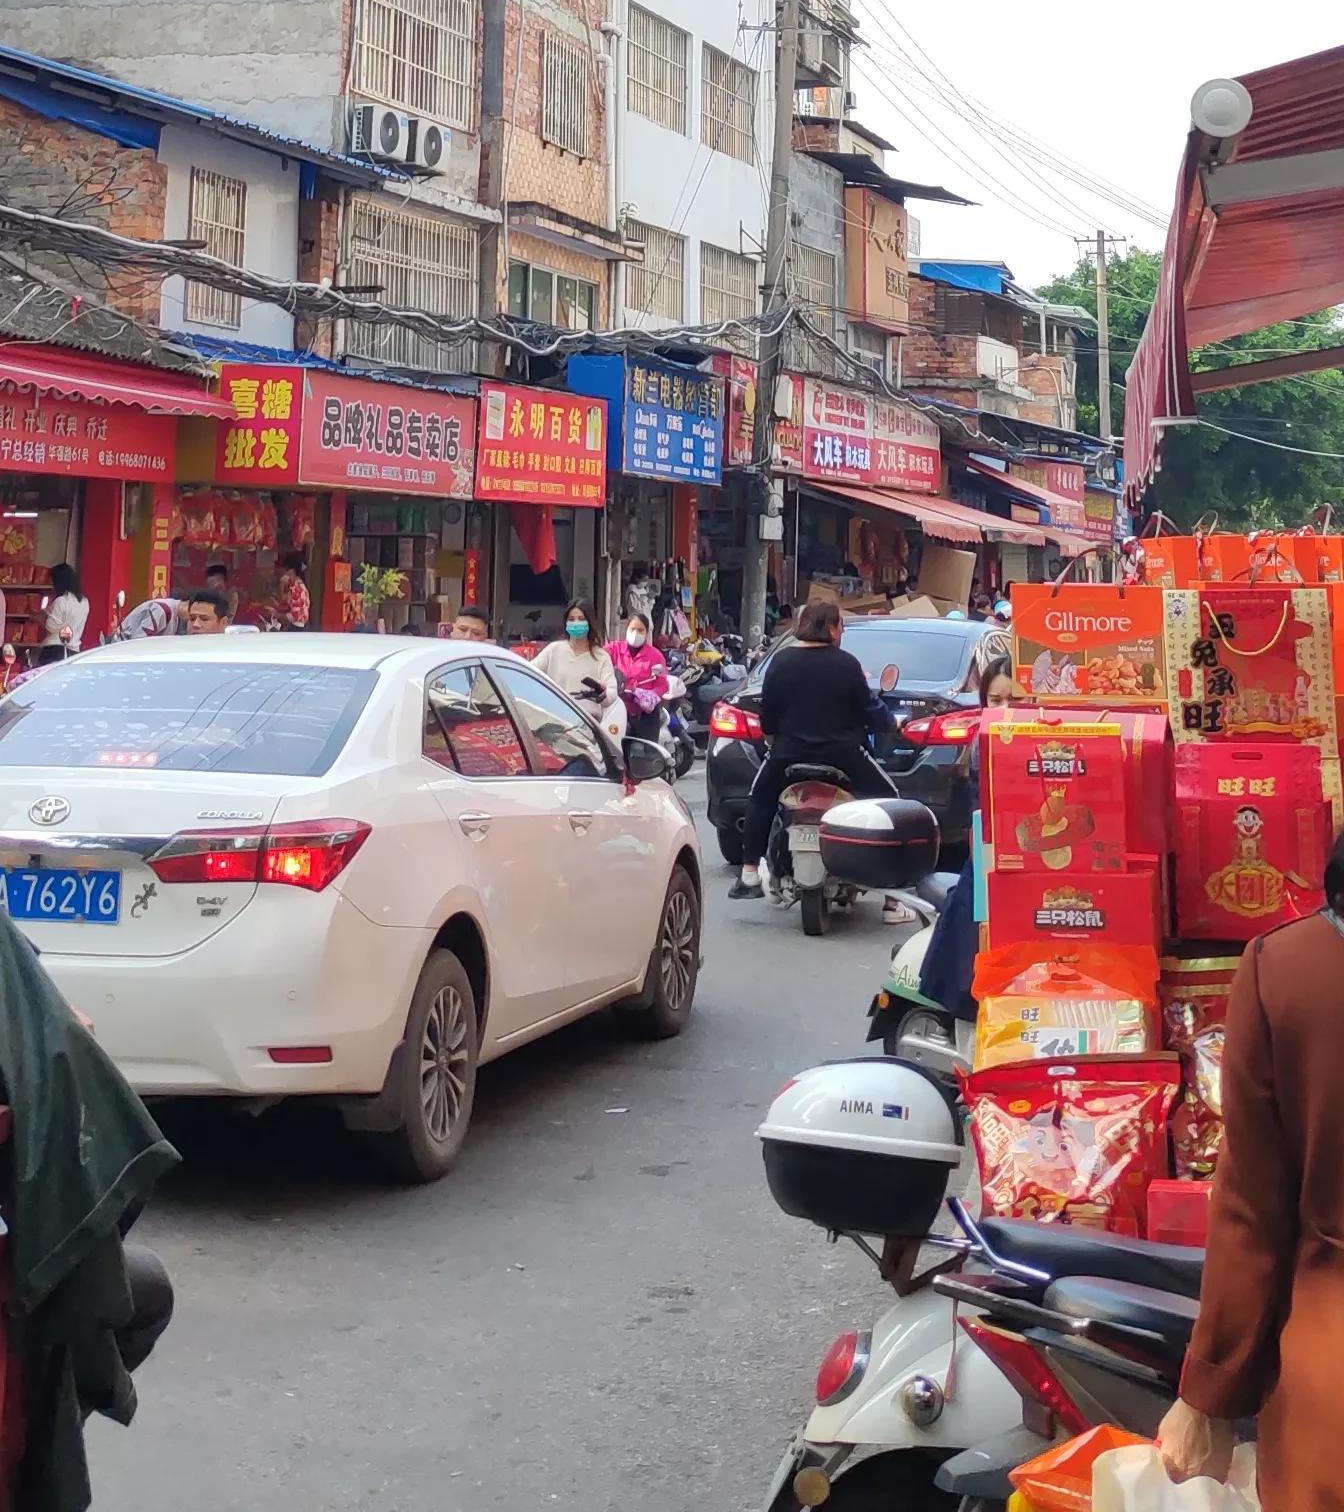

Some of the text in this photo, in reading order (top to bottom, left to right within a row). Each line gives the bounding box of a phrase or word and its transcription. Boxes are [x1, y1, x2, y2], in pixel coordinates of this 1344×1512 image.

[230, 378, 293, 419] 喜糖
[24, 409, 47, 434] 开业
[55, 412, 77, 437] 庆典
[321, 396, 461, 462] 品牌礼品专卖店
[509, 398, 582, 445] 永明百货
[224, 427, 290, 470] 批发
[814, 433, 842, 470] 大风车
[877, 442, 906, 474] 大风车
[196, 810, 263, 820] COROLLA
[1035, 910, 1104, 928] 三只松鼠
[840, 1100, 873, 1115] AIMA
